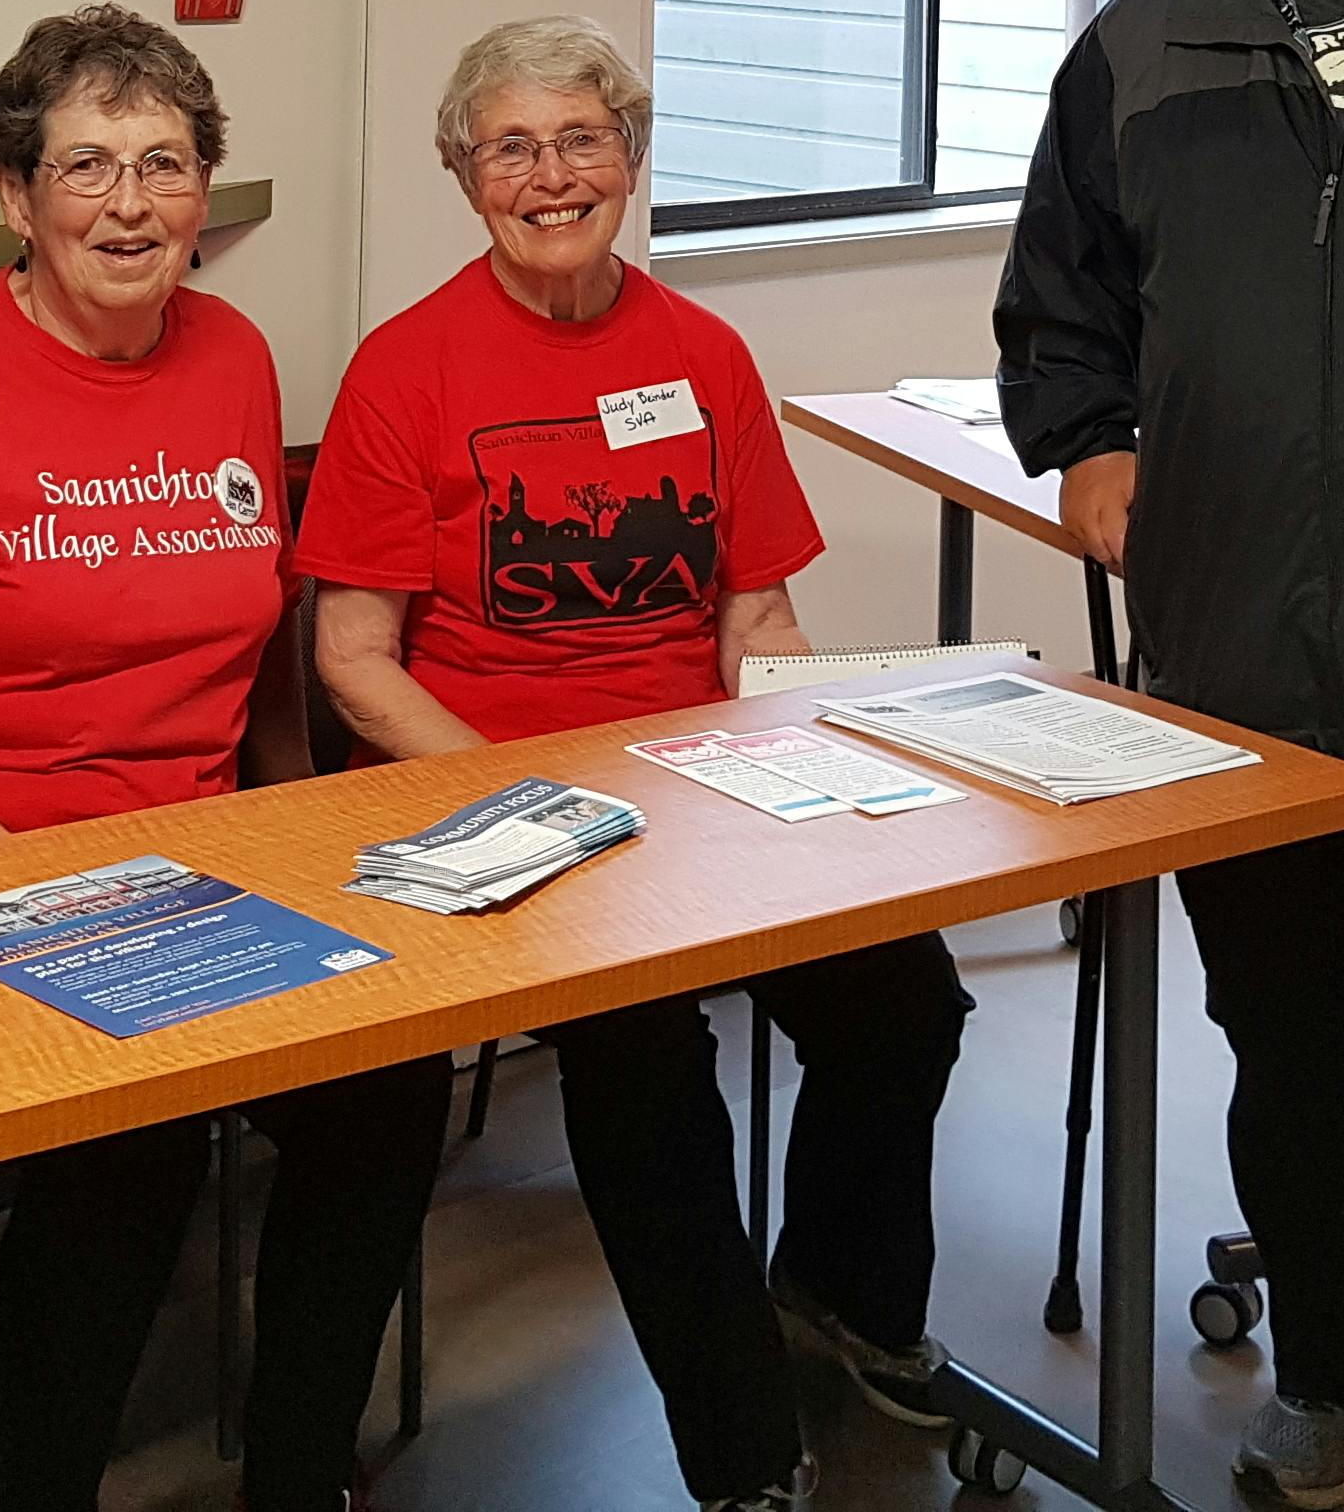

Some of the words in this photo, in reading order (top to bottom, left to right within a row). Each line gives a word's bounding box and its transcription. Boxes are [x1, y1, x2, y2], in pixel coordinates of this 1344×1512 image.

[602, 397, 635, 416] Judy
[624, 411, 656, 432] SVA
[563, 424, 605, 441] Villa
[37, 451, 217, 510] Saanichto
[131, 516, 282, 557] Association
[494, 553, 702, 618] SVA
[420, 803, 511, 845] COMMUNITY
[504, 785, 553, 807] FOCUS
[112, 898, 191, 923] VILLAGE
[23, 963, 45, 973] Be
[57, 952, 88, 965] part
[87, 948, 103, 956] of
[104, 928, 177, 951] developing
[186, 913, 229, 928] design
[34, 966, 66, 979] plan
[66, 959, 88, 970] for
[89, 953, 114, 963] the
[113, 940, 159, 956] village
